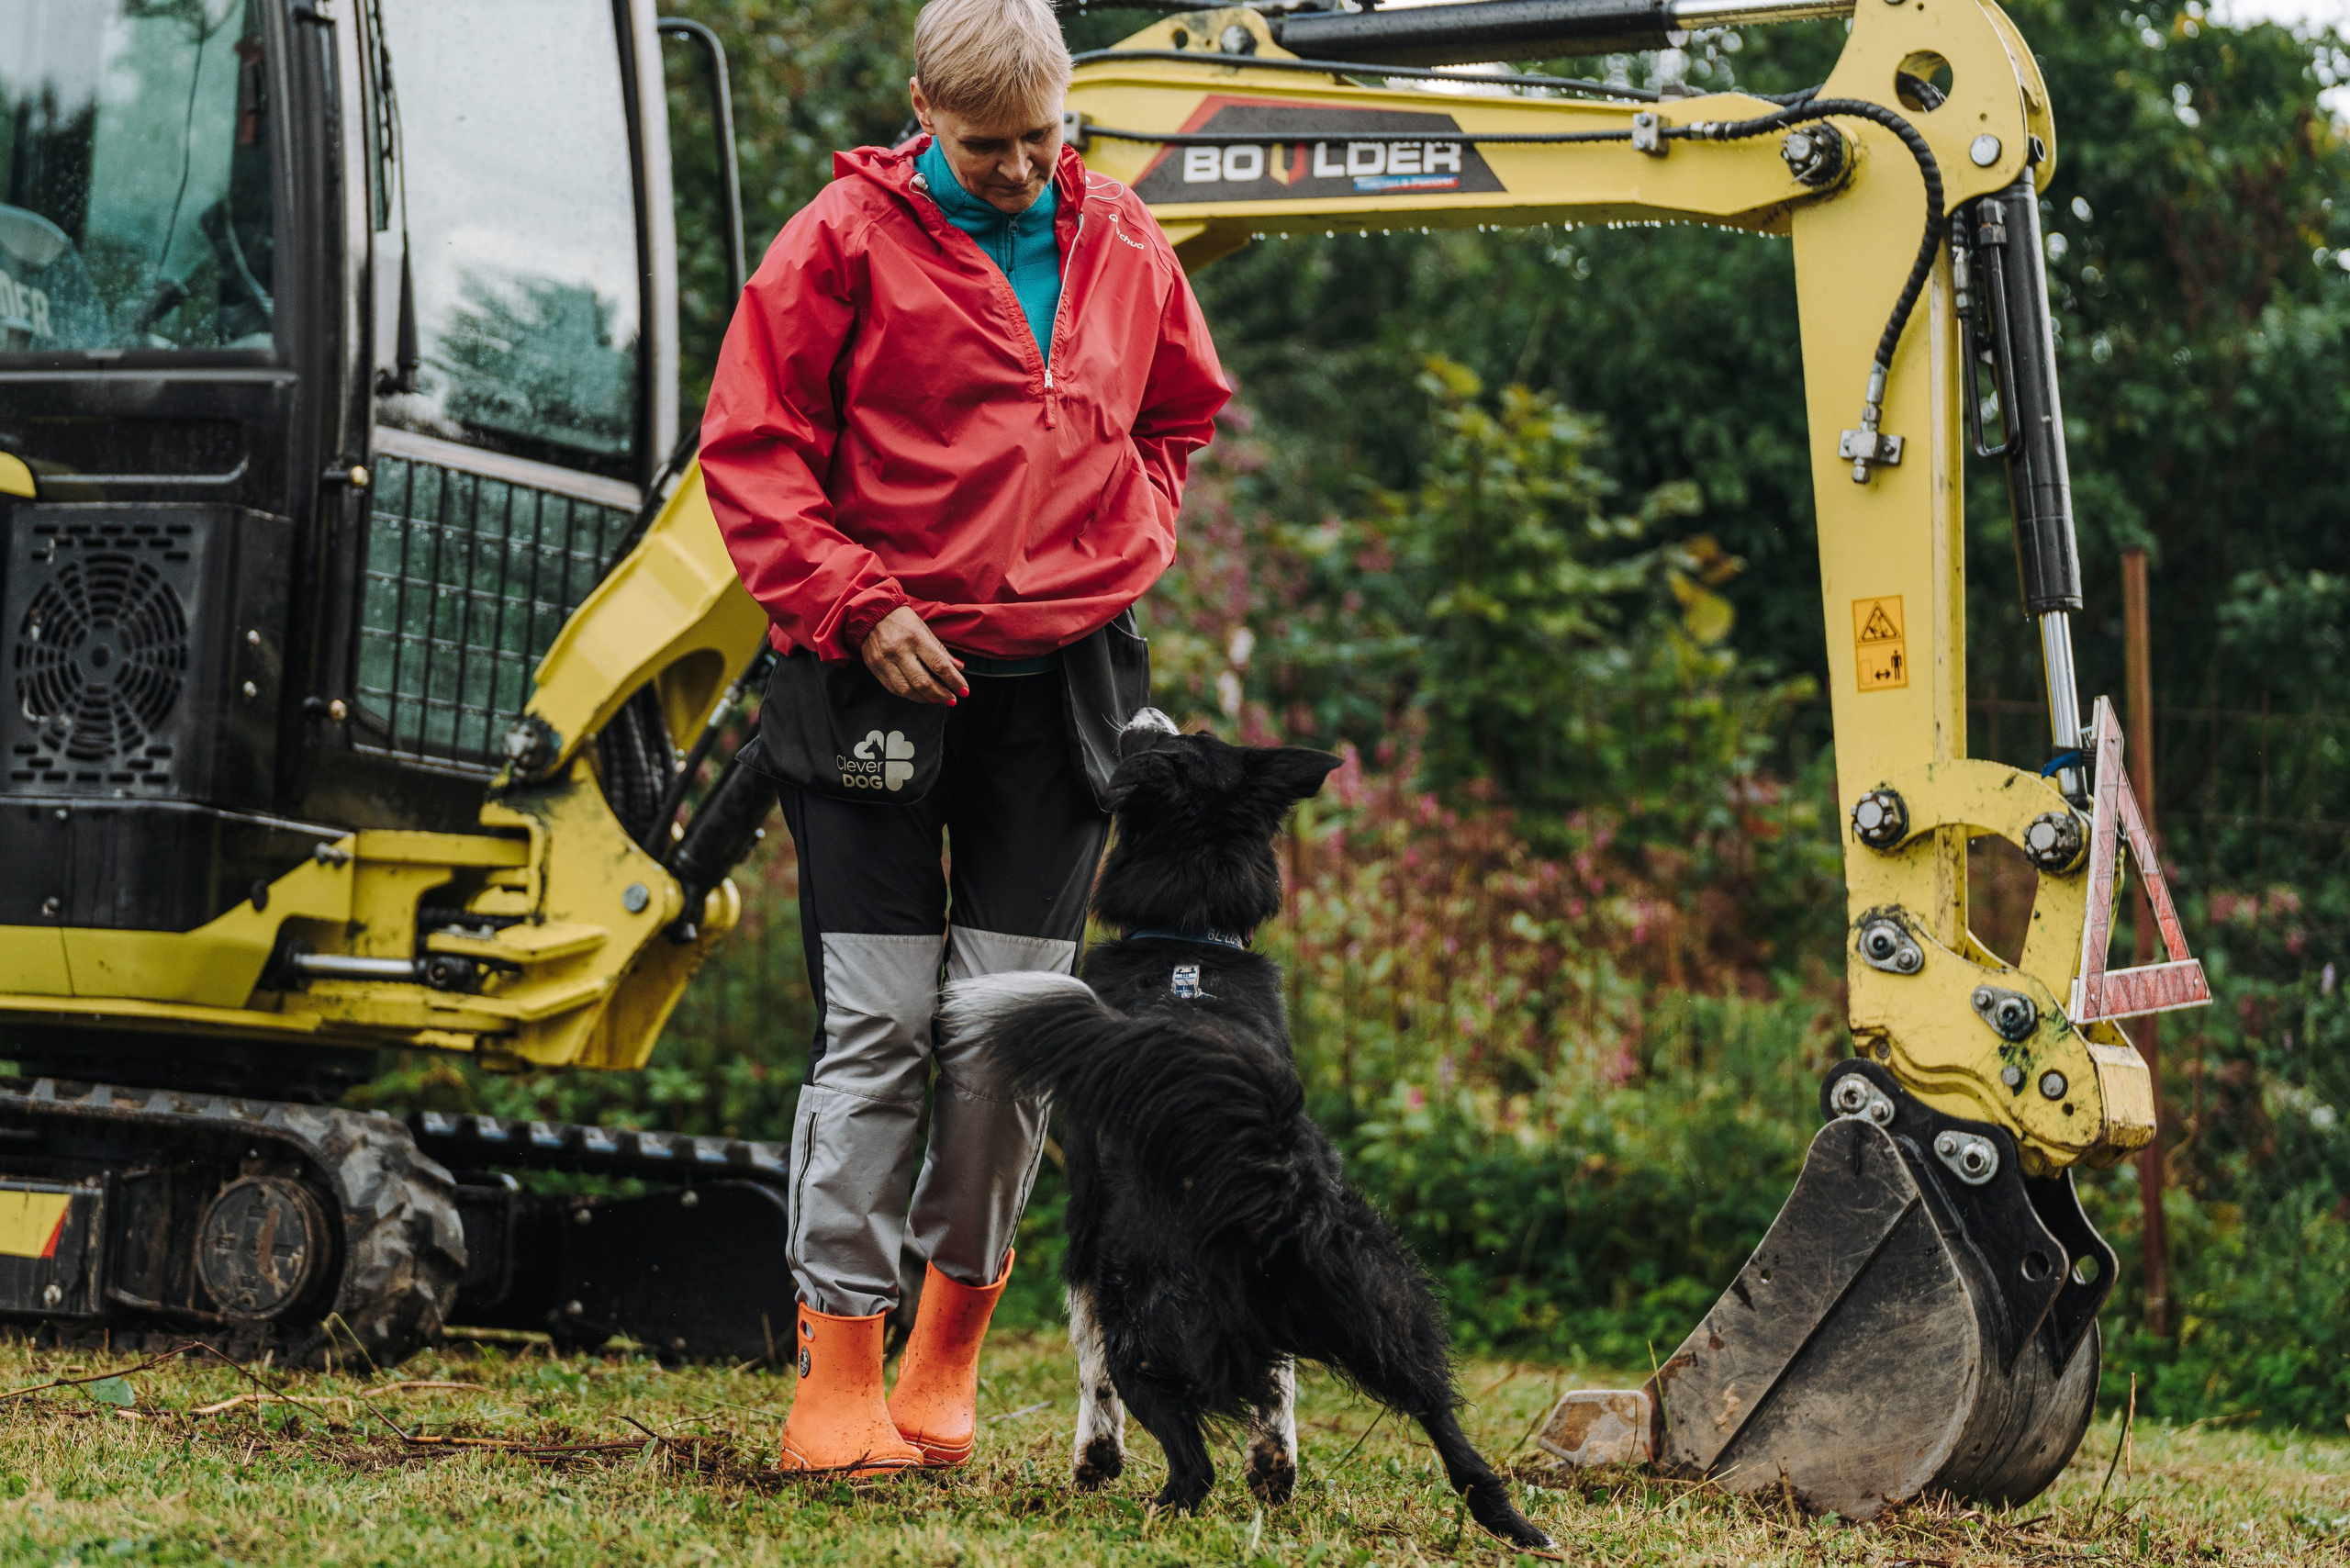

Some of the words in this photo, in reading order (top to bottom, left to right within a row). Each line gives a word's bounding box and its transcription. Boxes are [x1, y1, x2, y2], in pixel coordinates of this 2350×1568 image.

[1182, 140, 1462, 185] BOULDER
[836, 755, 883, 772] Clever
[842, 773, 883, 790] DOG
